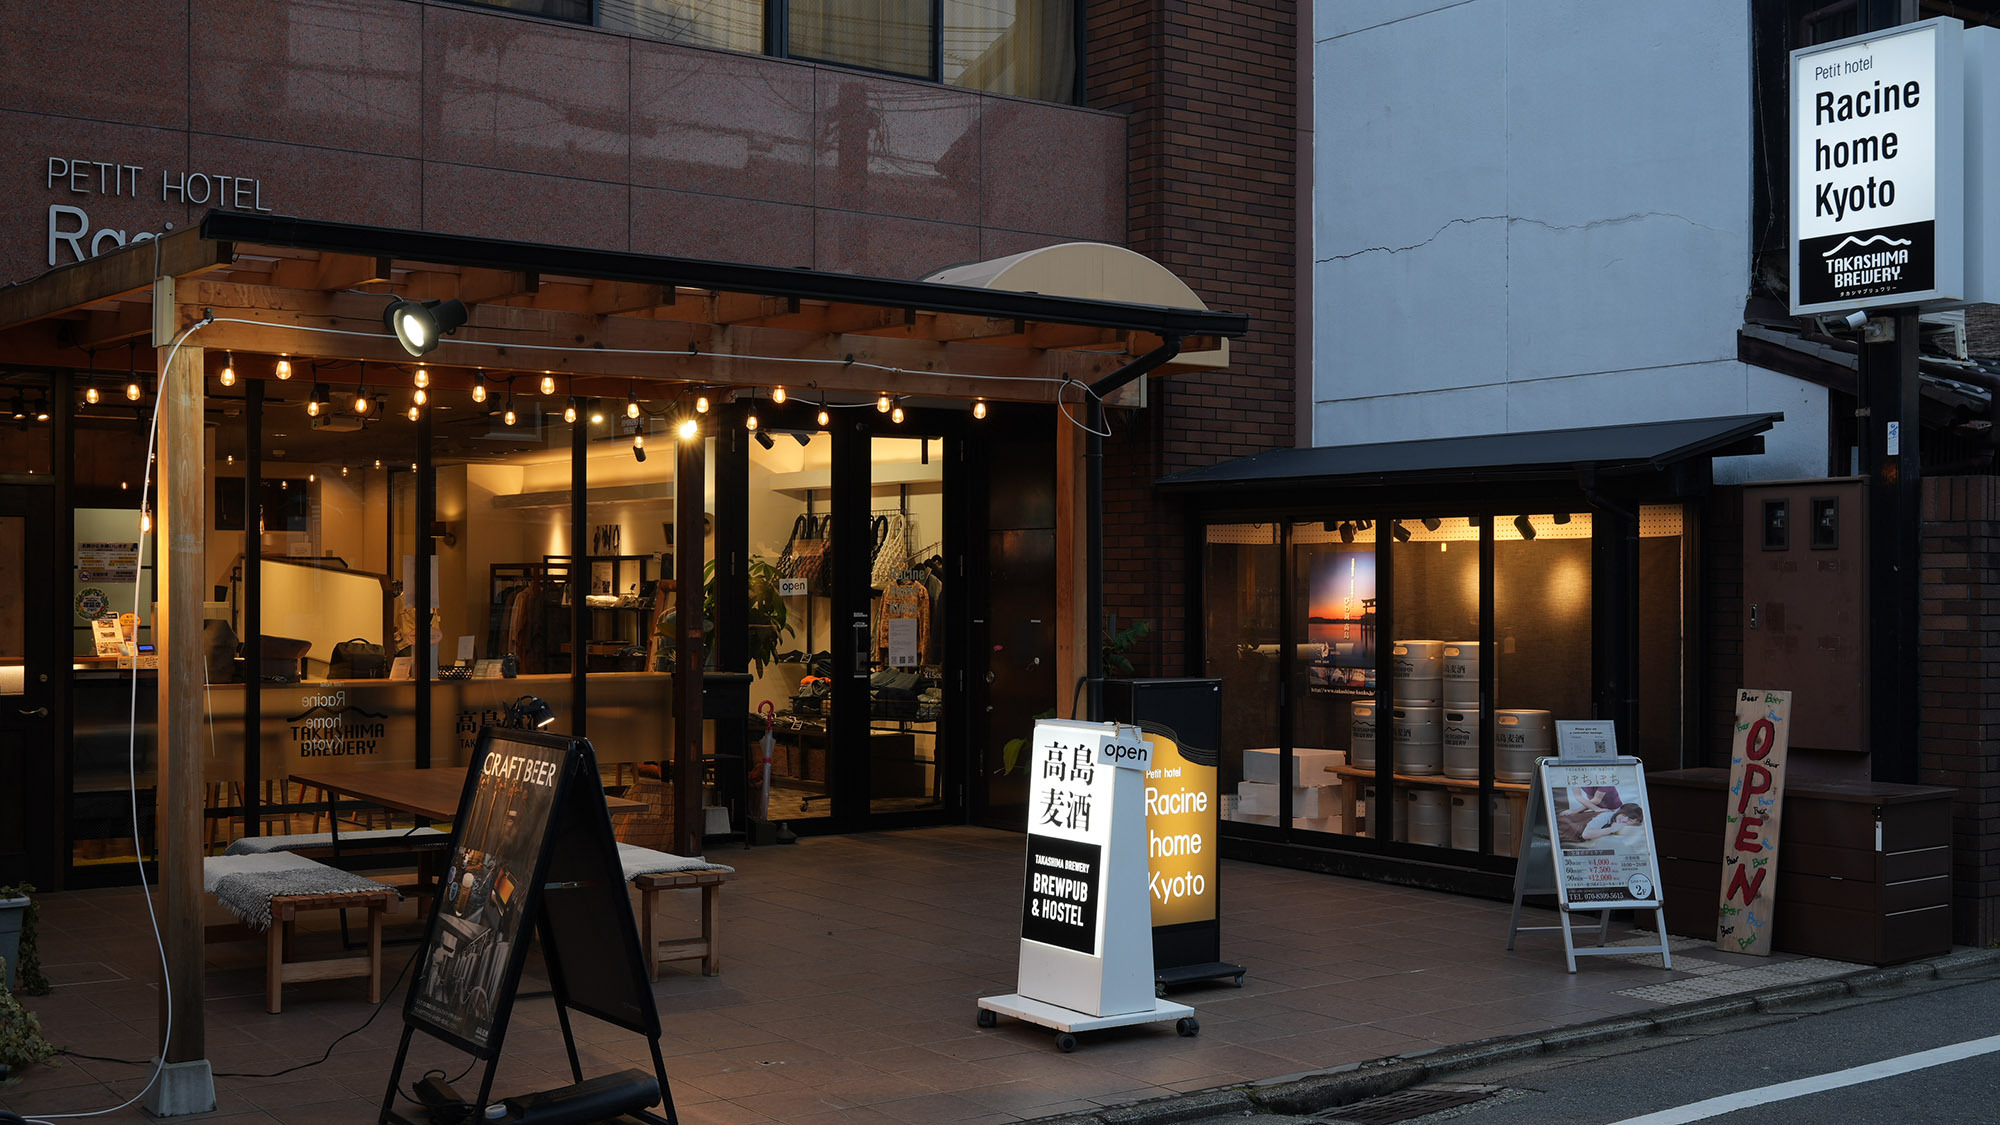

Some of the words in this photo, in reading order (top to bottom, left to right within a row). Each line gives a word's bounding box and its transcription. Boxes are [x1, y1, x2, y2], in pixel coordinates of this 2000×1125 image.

[1815, 63, 1841, 80] Petit
[1845, 55, 1873, 74] hotel
[1816, 80, 1920, 126] Racine
[1816, 132, 1898, 171] home
[48, 157, 143, 197] PETIT
[163, 170, 272, 212] HOTEL
[1816, 176, 1895, 222] Kyoto
[1826, 249, 1909, 274] TAKASHIMA
[1834, 266, 1901, 288] BREWERY
[782, 582, 805, 593] open
[889, 567, 925, 580] Racine
[889, 601, 917, 616] Kyoto
[290, 724, 385, 741] TAKASHIMA
[301, 741, 376, 757] BREWERY
[1043, 741, 1095, 786] 高島
[1104, 743, 1148, 763] open
[483, 752, 525, 780] CRAFT
[523, 759, 557, 787] BEER
[1146, 769, 1162, 779] Petit
[1164, 767, 1181, 778] hotel
[1040, 788, 1092, 832] 麦酒
[1144, 787, 1207, 817] Racine
[1726, 718, 1775, 907] OPEN
[1149, 829, 1202, 858] home
[1035, 854, 1064, 869] TAKASHIMA
[1065, 860, 1090, 874] BREWERY
[1033, 873, 1088, 902] BREWPUB
[1147, 870, 1205, 905] Kyoto
[1635, 884, 1647, 896] 2F
[1031, 898, 1040, 917] &
[1042, 899, 1084, 927] HOSTEL
